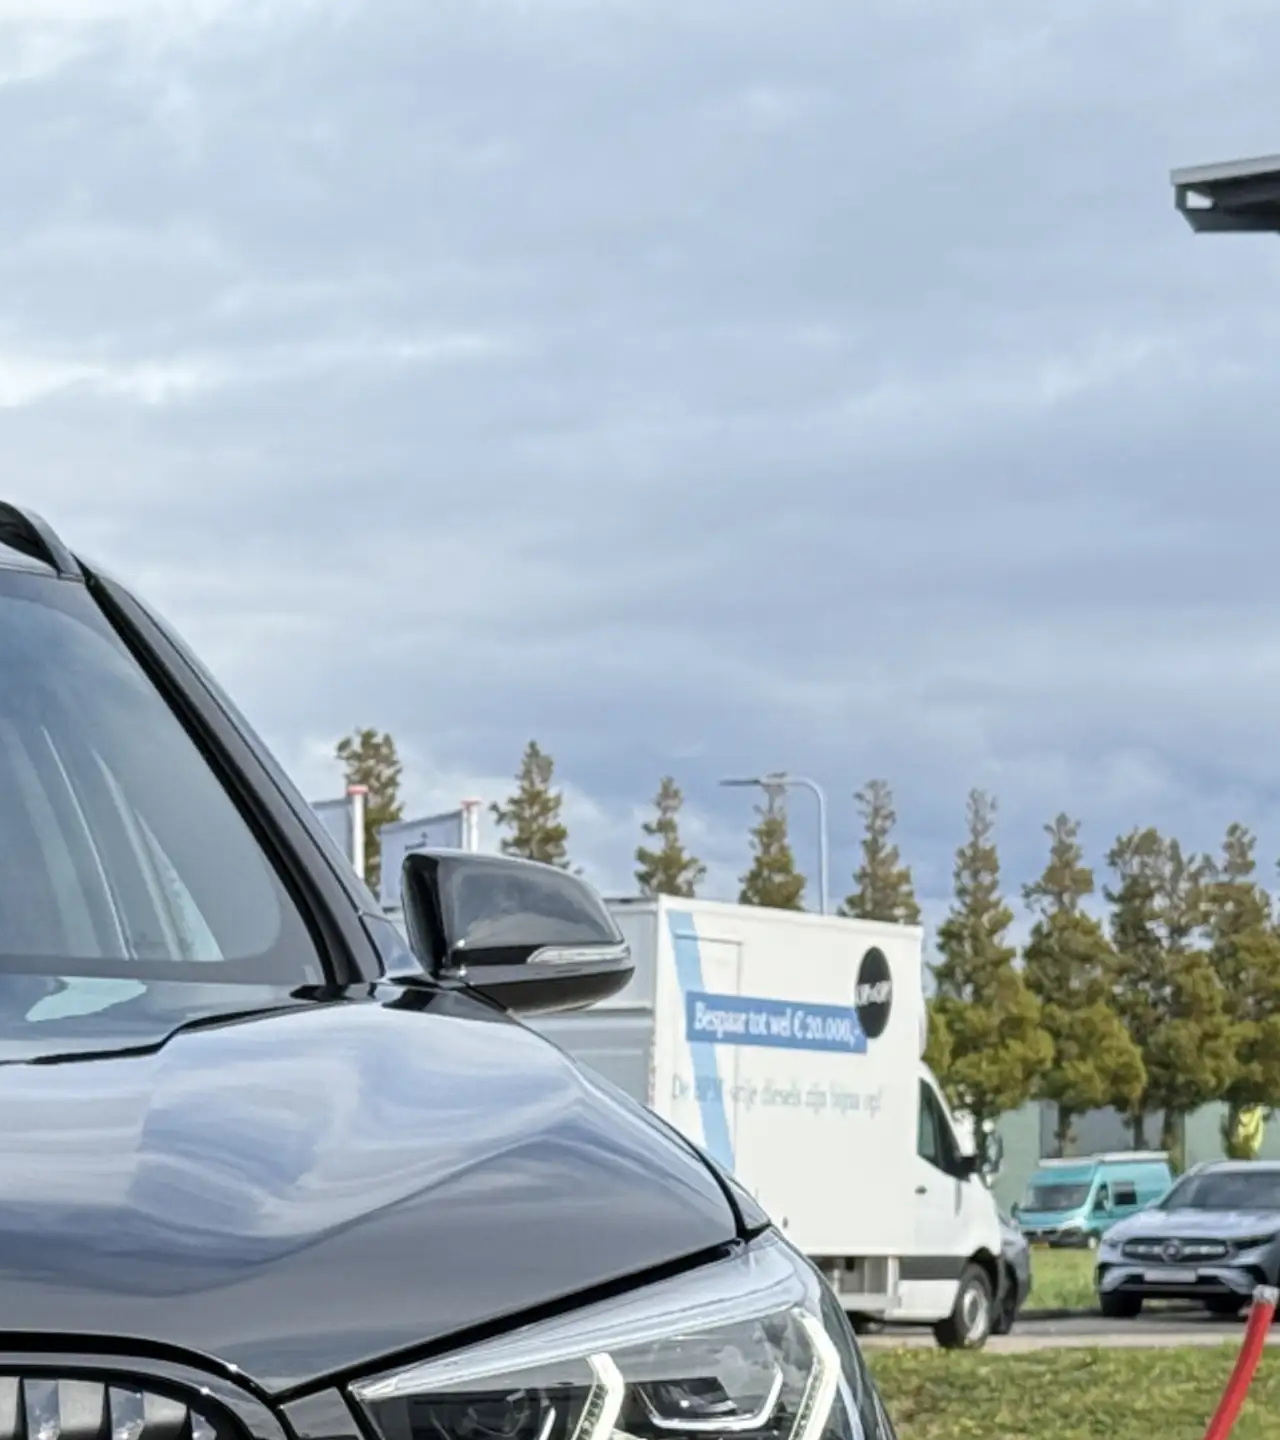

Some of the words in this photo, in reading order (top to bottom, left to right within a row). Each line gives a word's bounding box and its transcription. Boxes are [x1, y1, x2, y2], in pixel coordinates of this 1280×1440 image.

[694, 1001, 746, 1039] Bespaar
[748, 1011, 768, 1036] tot
[769, 1008, 792, 1040] wel
